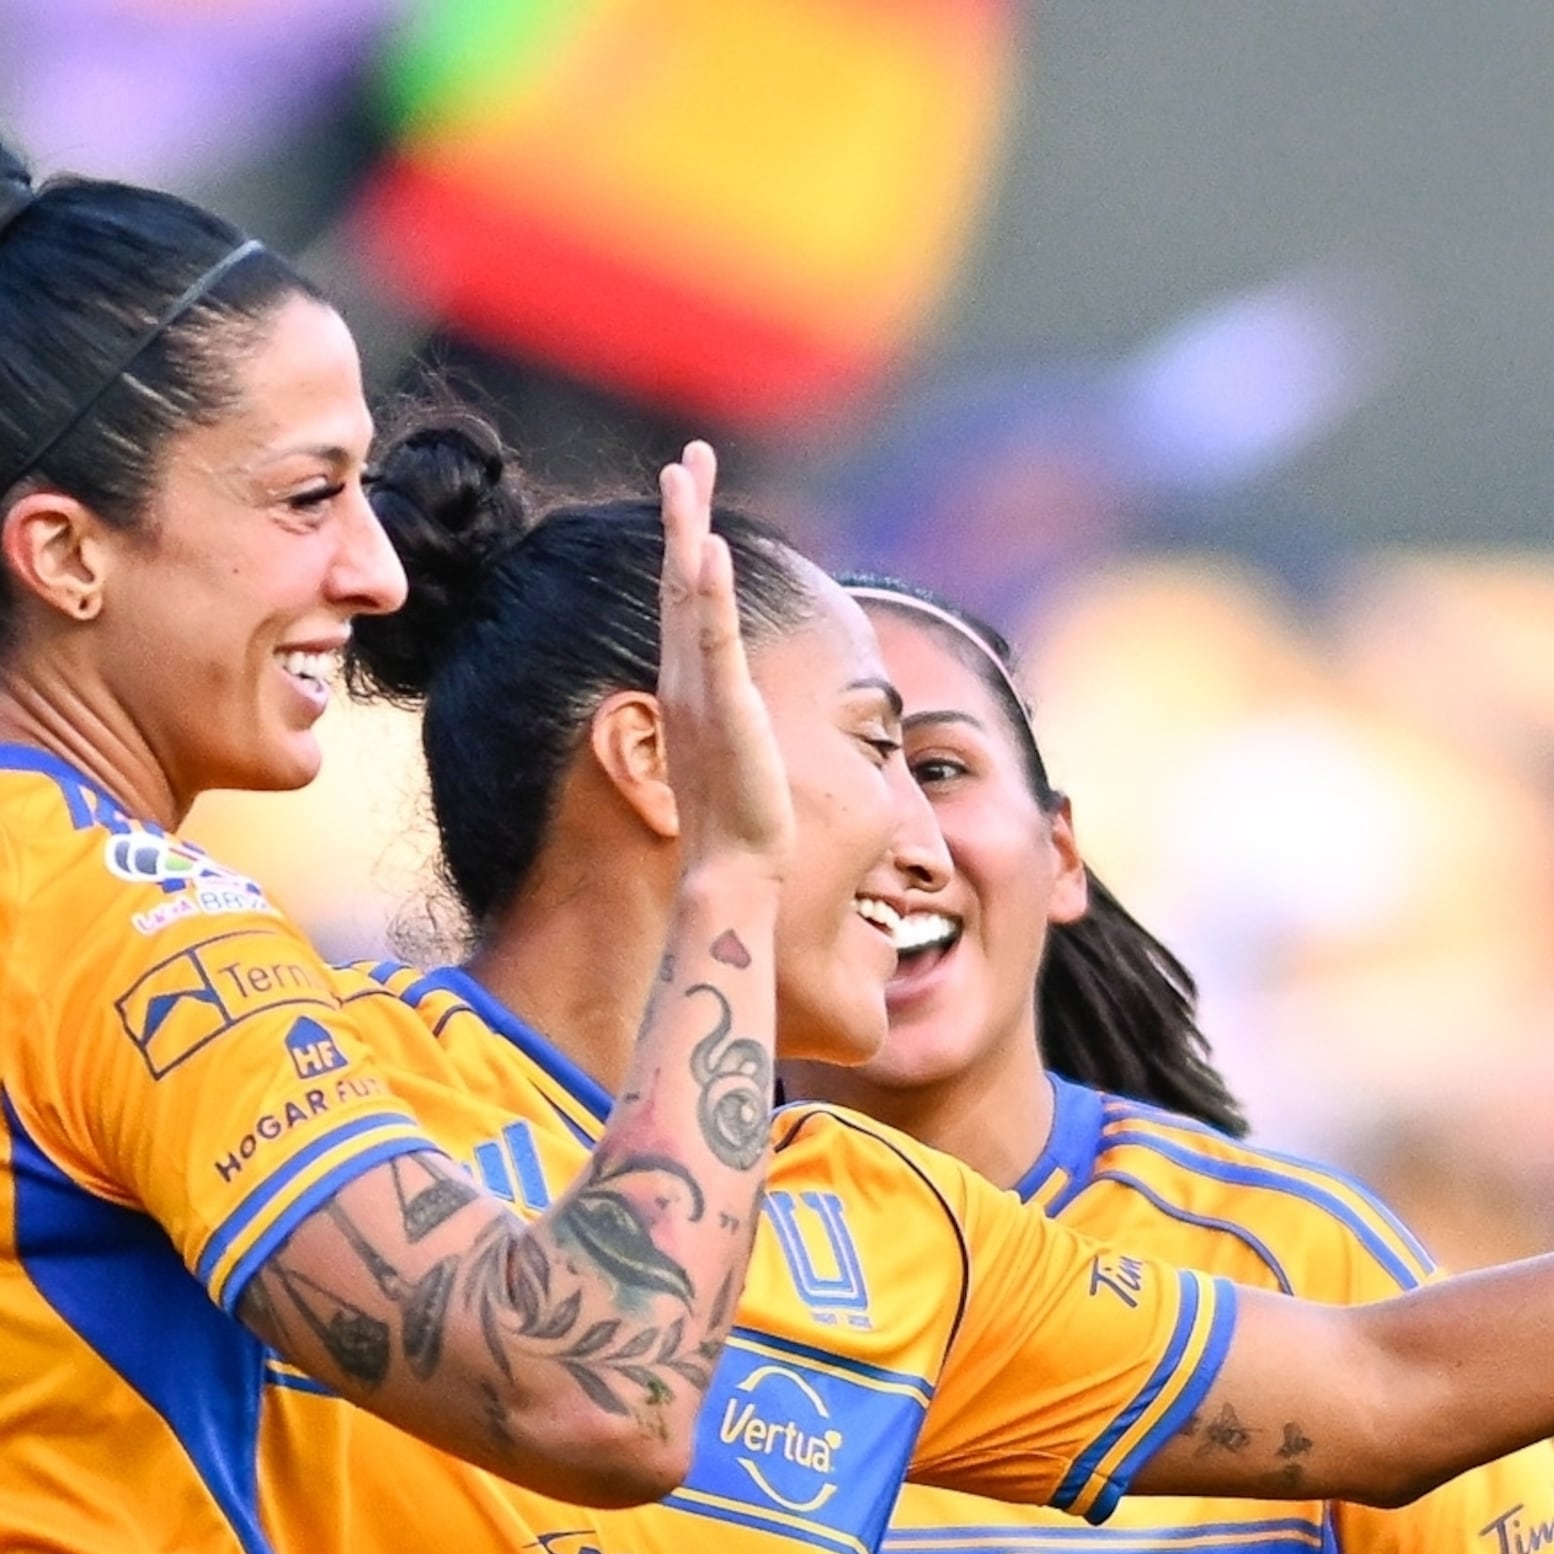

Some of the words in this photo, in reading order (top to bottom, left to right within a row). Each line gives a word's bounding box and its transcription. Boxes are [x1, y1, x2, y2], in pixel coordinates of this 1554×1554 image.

[291, 1040, 335, 1076] HF
[215, 1088, 329, 1183] HOGAR
[719, 1397, 834, 1473] Vertua
